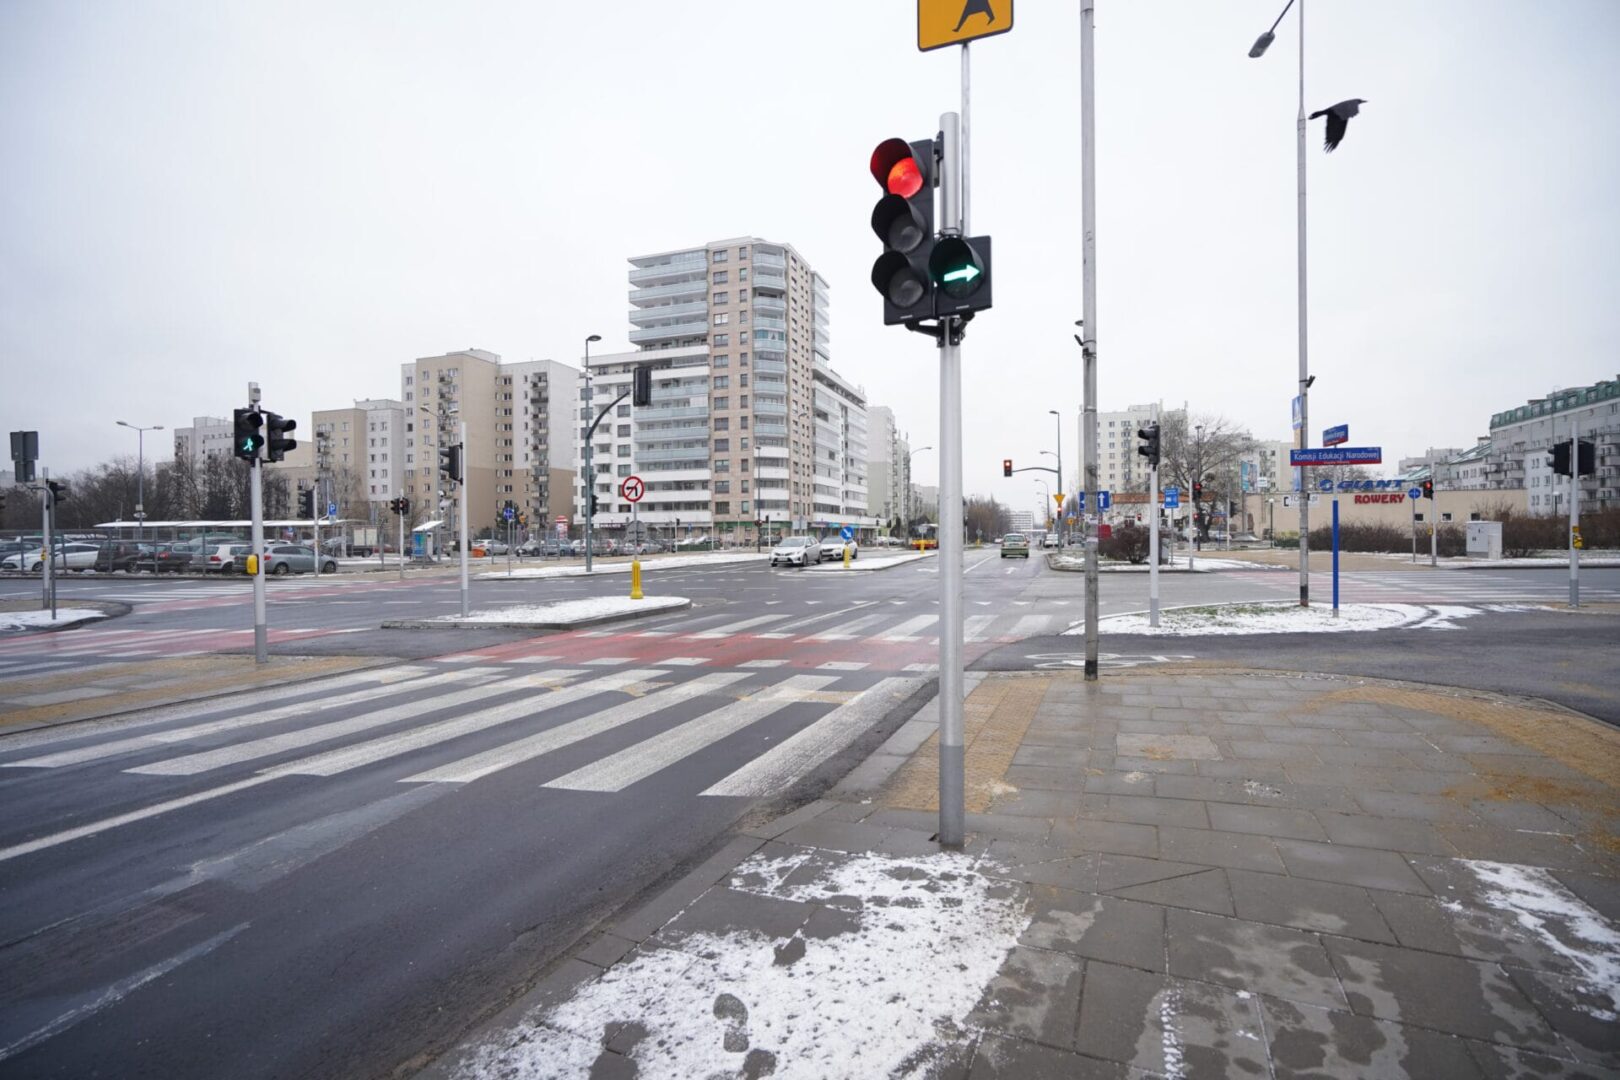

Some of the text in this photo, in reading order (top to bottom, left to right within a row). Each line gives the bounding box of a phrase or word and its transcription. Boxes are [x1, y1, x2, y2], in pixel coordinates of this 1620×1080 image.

[1294, 451, 1379, 461] Komisji Edukacji Narodowej
[1337, 479, 1403, 490] GIANT
[1354, 493, 1405, 504] ROWERY
